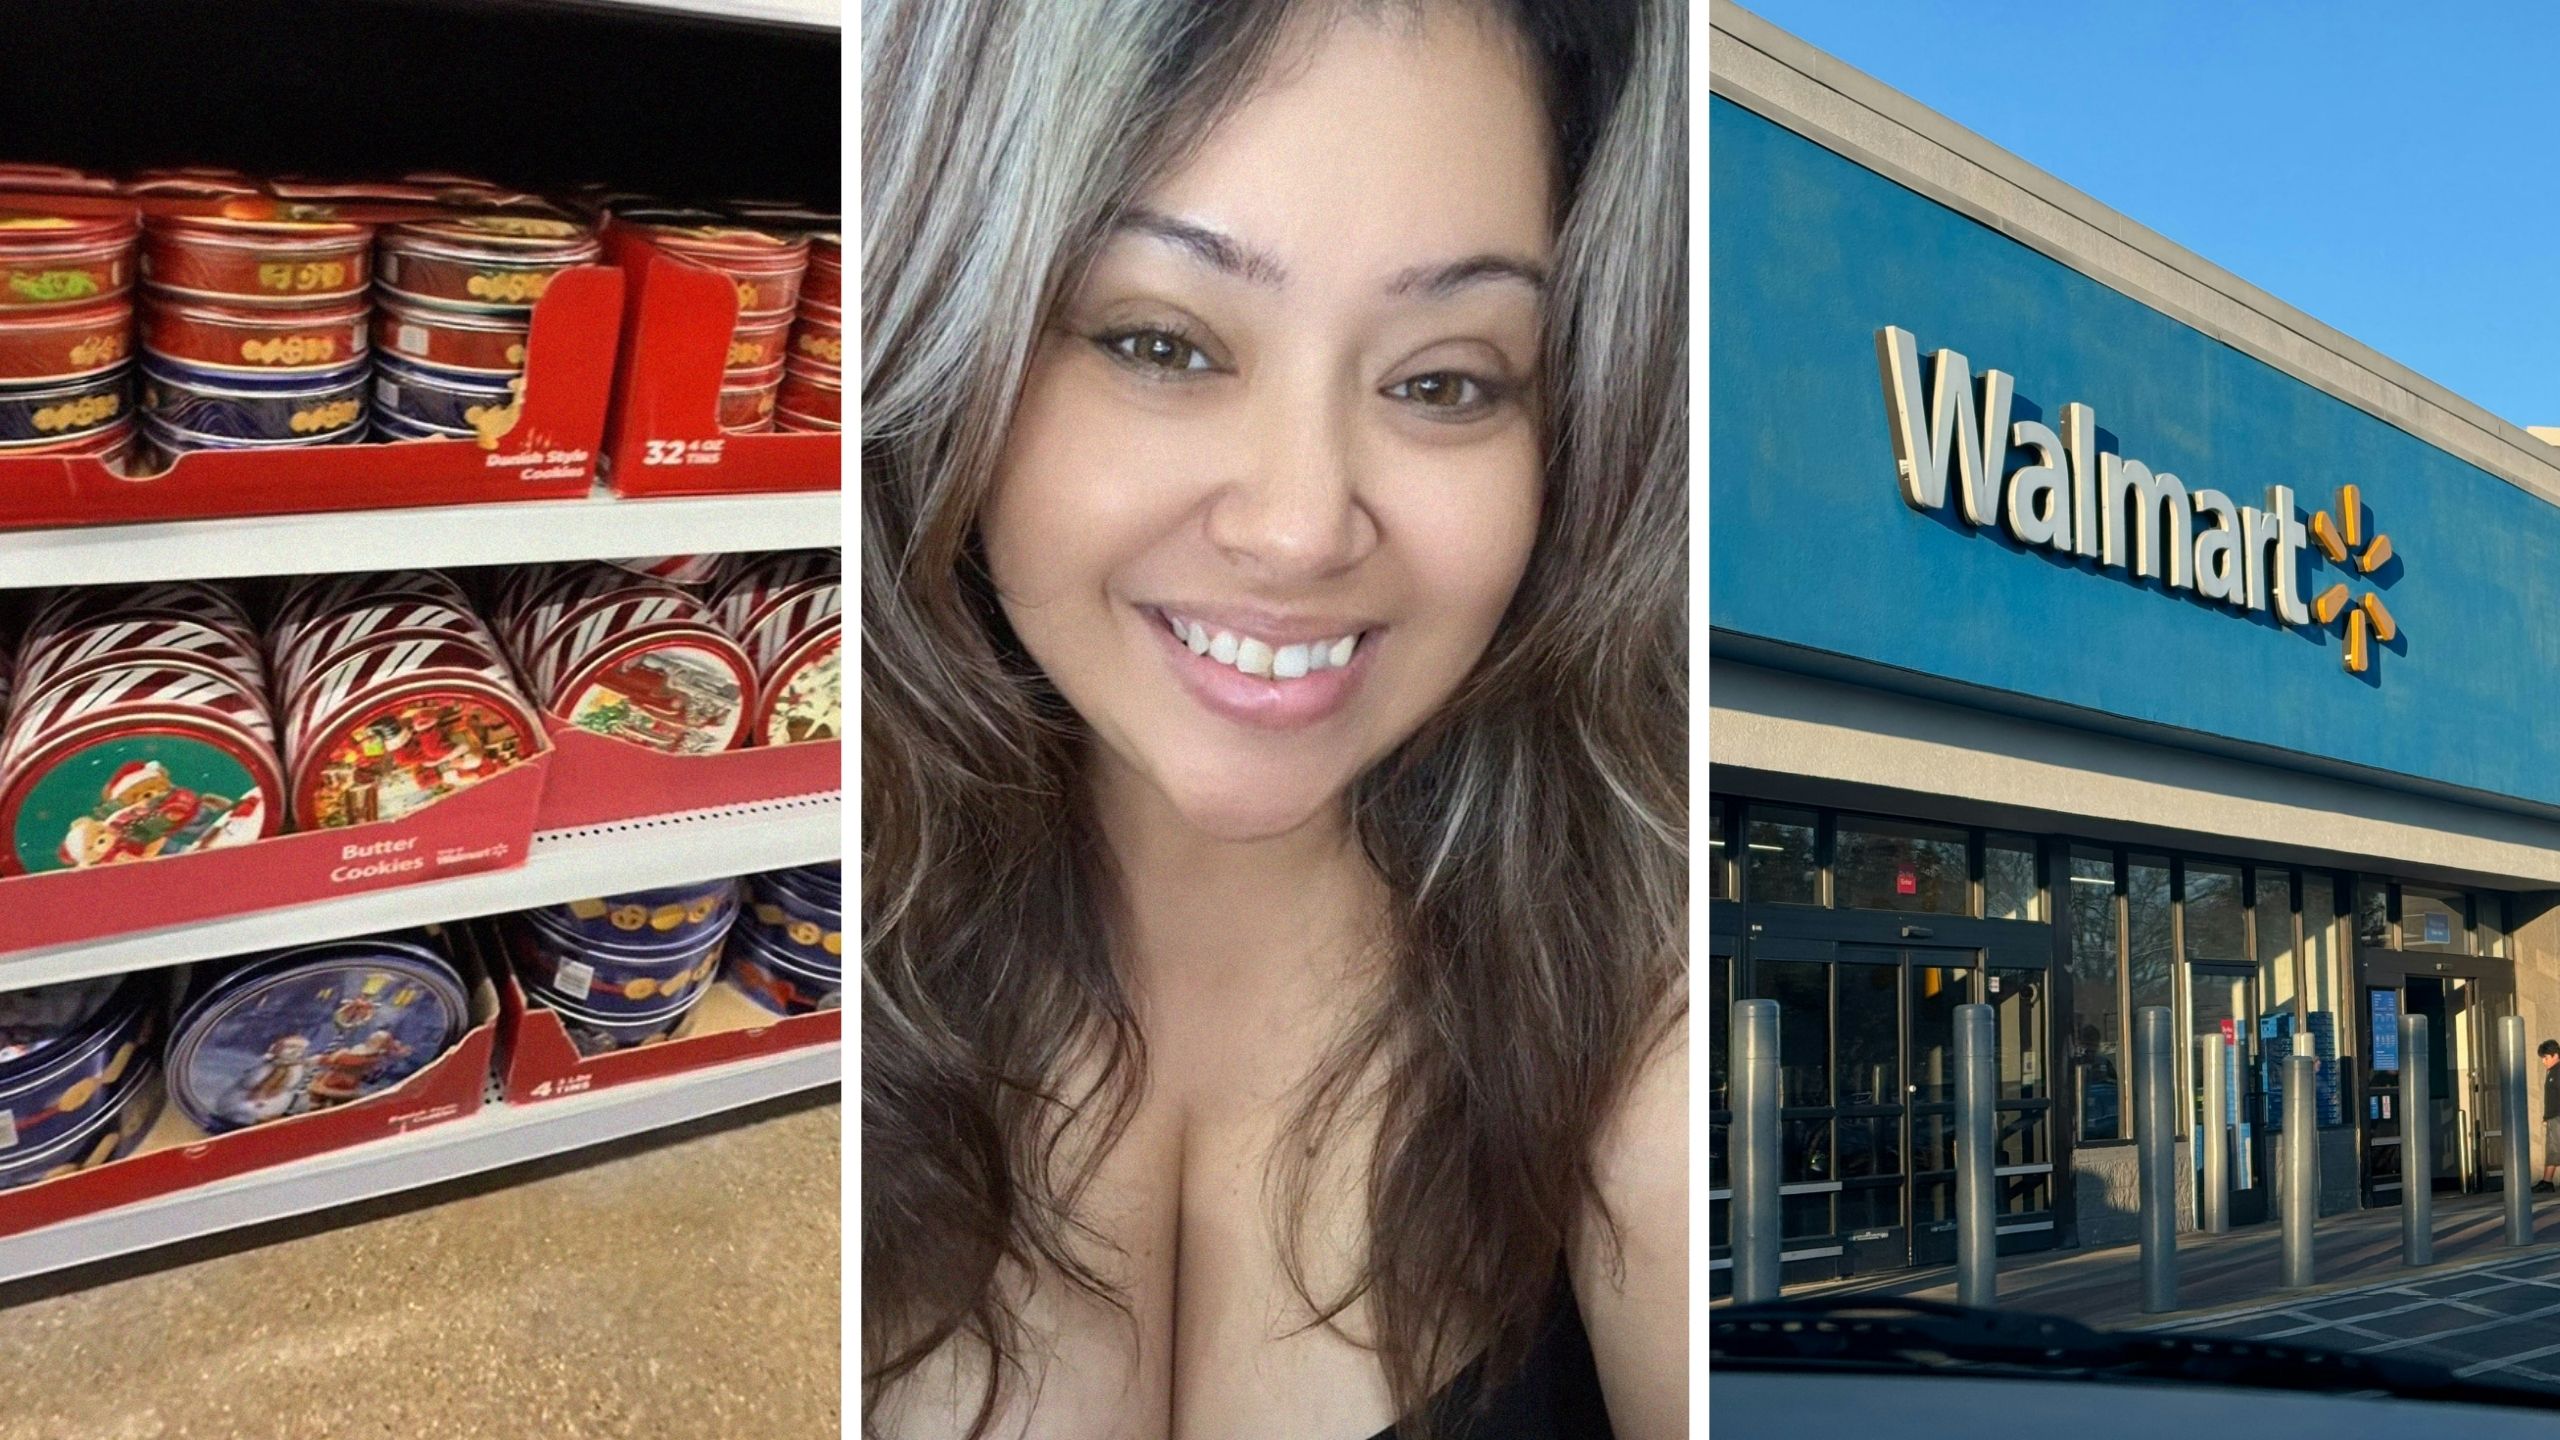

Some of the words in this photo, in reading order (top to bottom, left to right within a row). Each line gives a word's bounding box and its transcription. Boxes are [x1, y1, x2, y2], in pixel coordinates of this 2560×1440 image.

[546, 448, 588, 465] Style
[643, 440, 686, 465] 32
[521, 465, 585, 480] Cookies
[1875, 325, 2309, 625] Walmart
[342, 836, 418, 860] Butter
[330, 857, 424, 882] Cookies
[530, 1080, 552, 1096] 4
